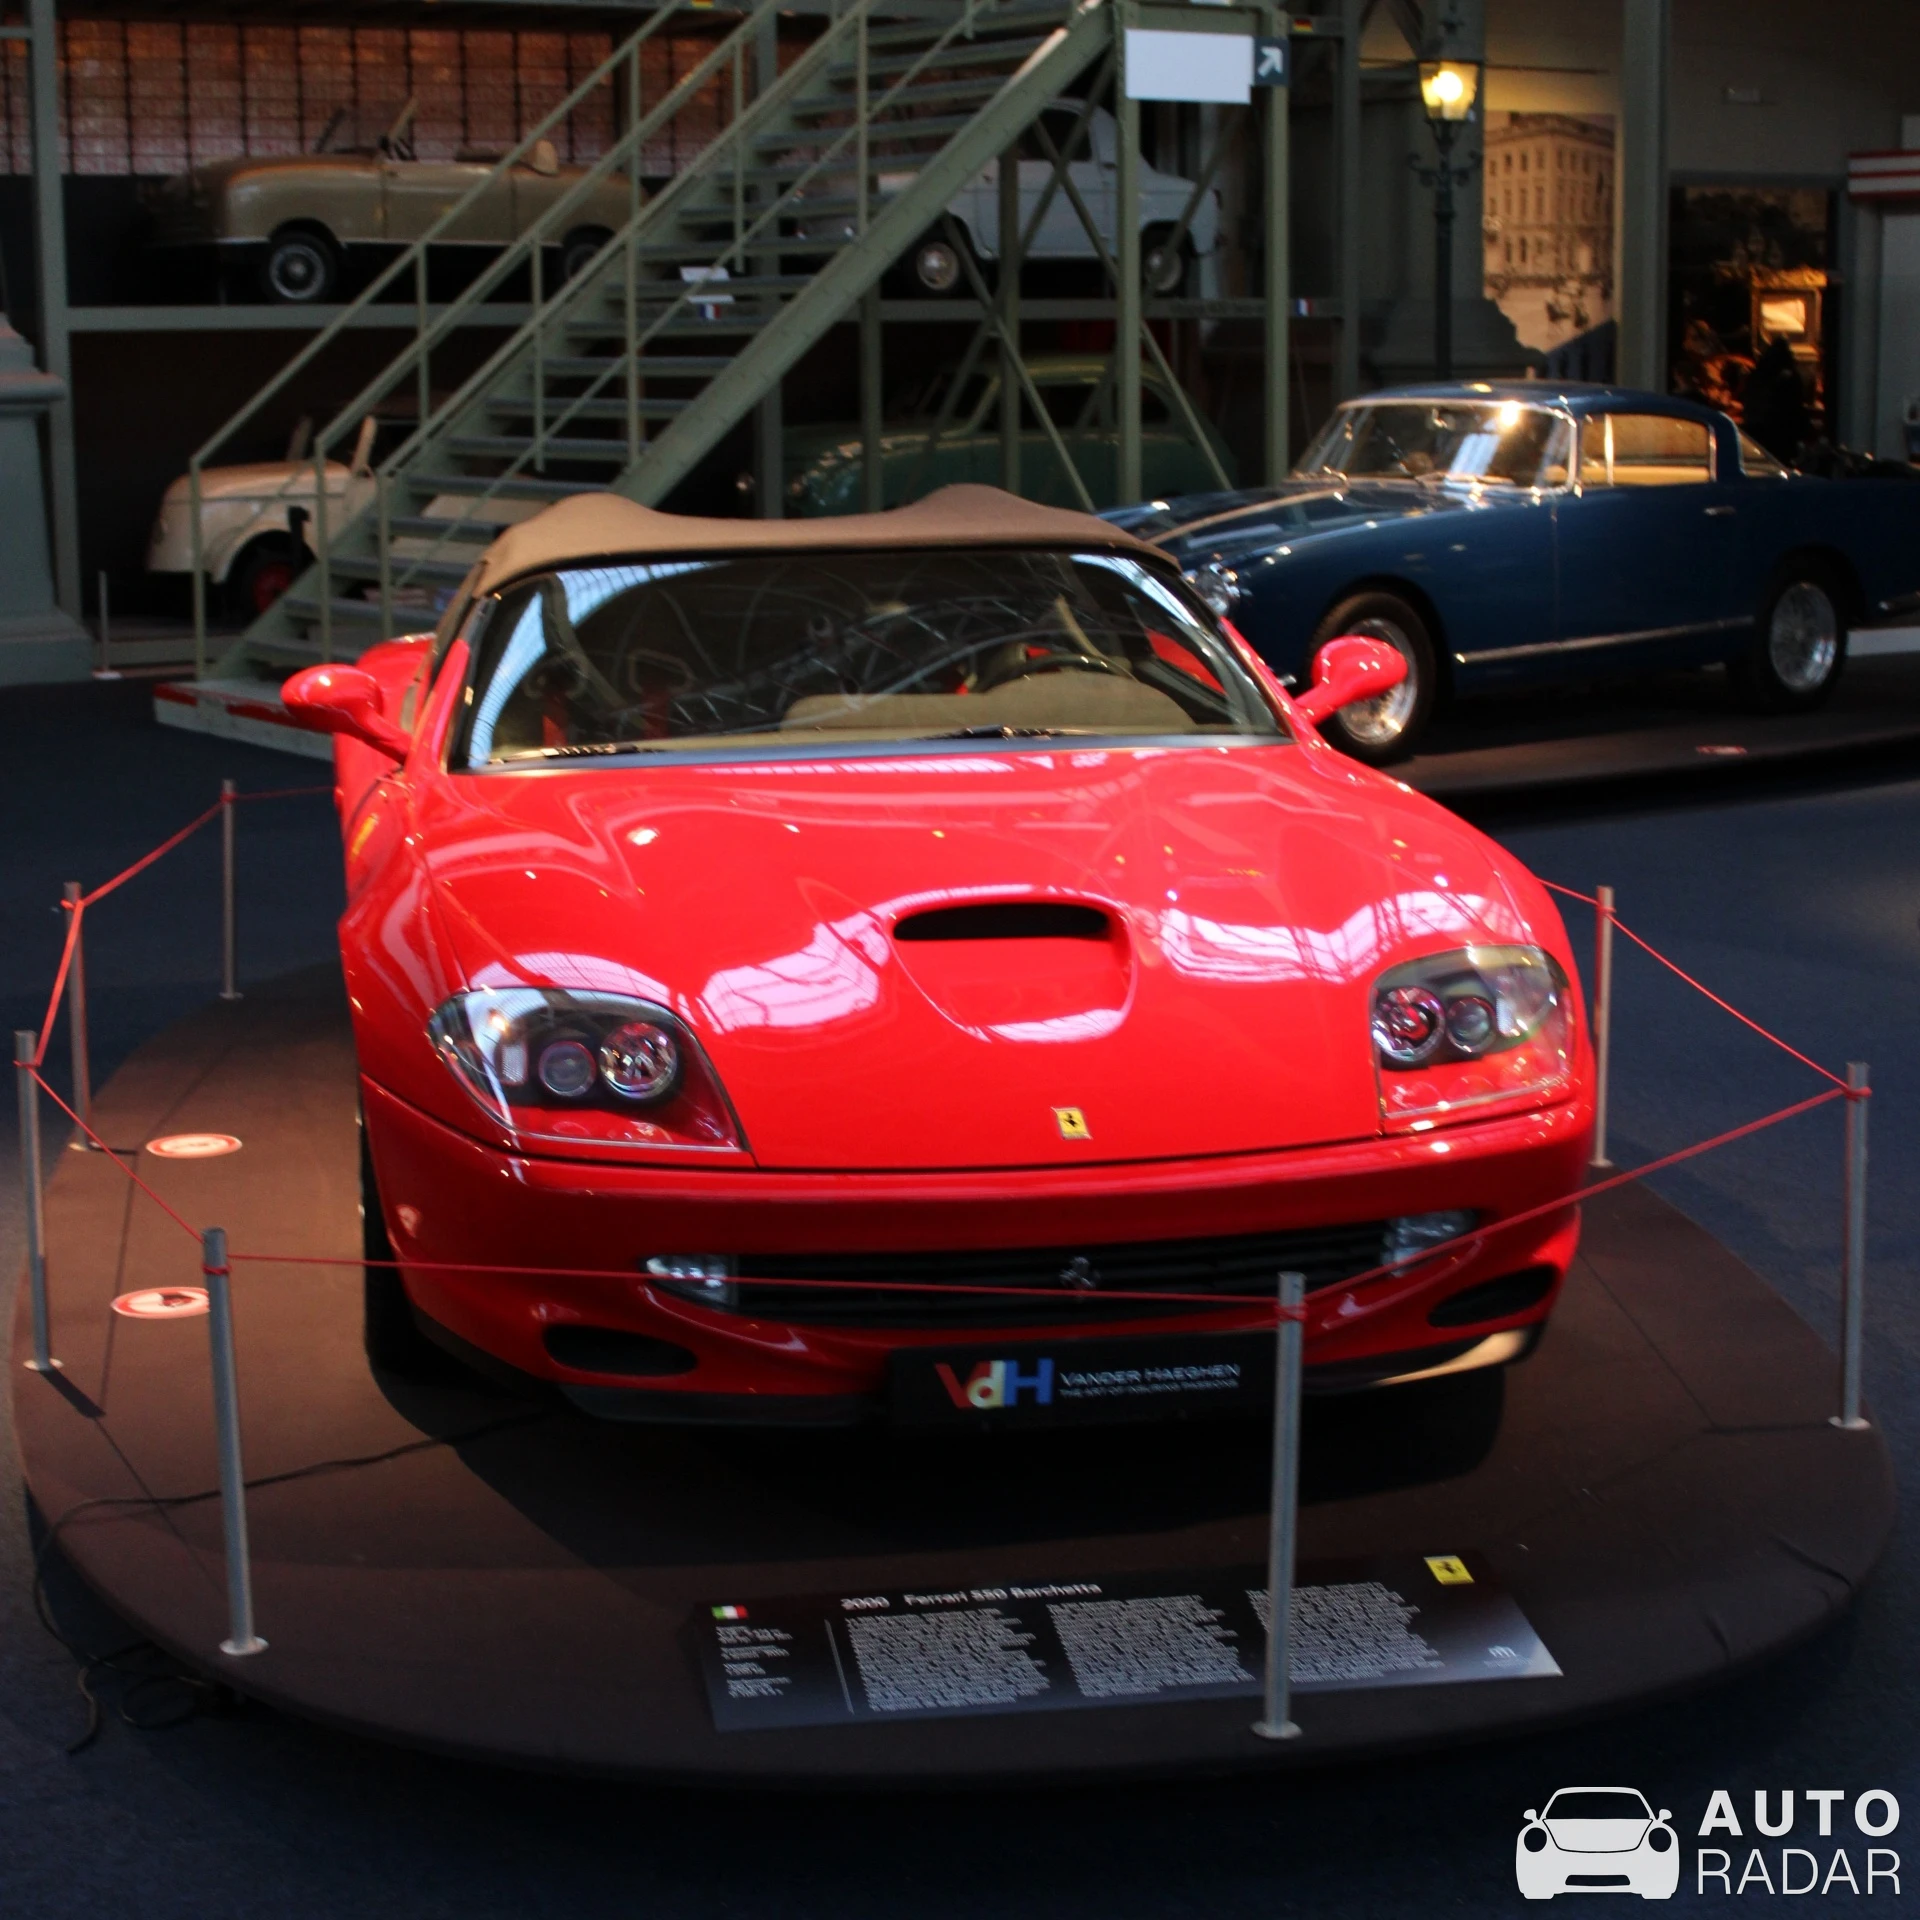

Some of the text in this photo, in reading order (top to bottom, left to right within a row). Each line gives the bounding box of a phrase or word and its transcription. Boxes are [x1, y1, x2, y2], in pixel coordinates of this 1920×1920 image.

[1059, 1370, 1142, 1388] VANDER
[841, 1596, 890, 1611] 2000
[904, 1591, 968, 1606] Ferrari
[1009, 1583, 1102, 1599] Barchetta
